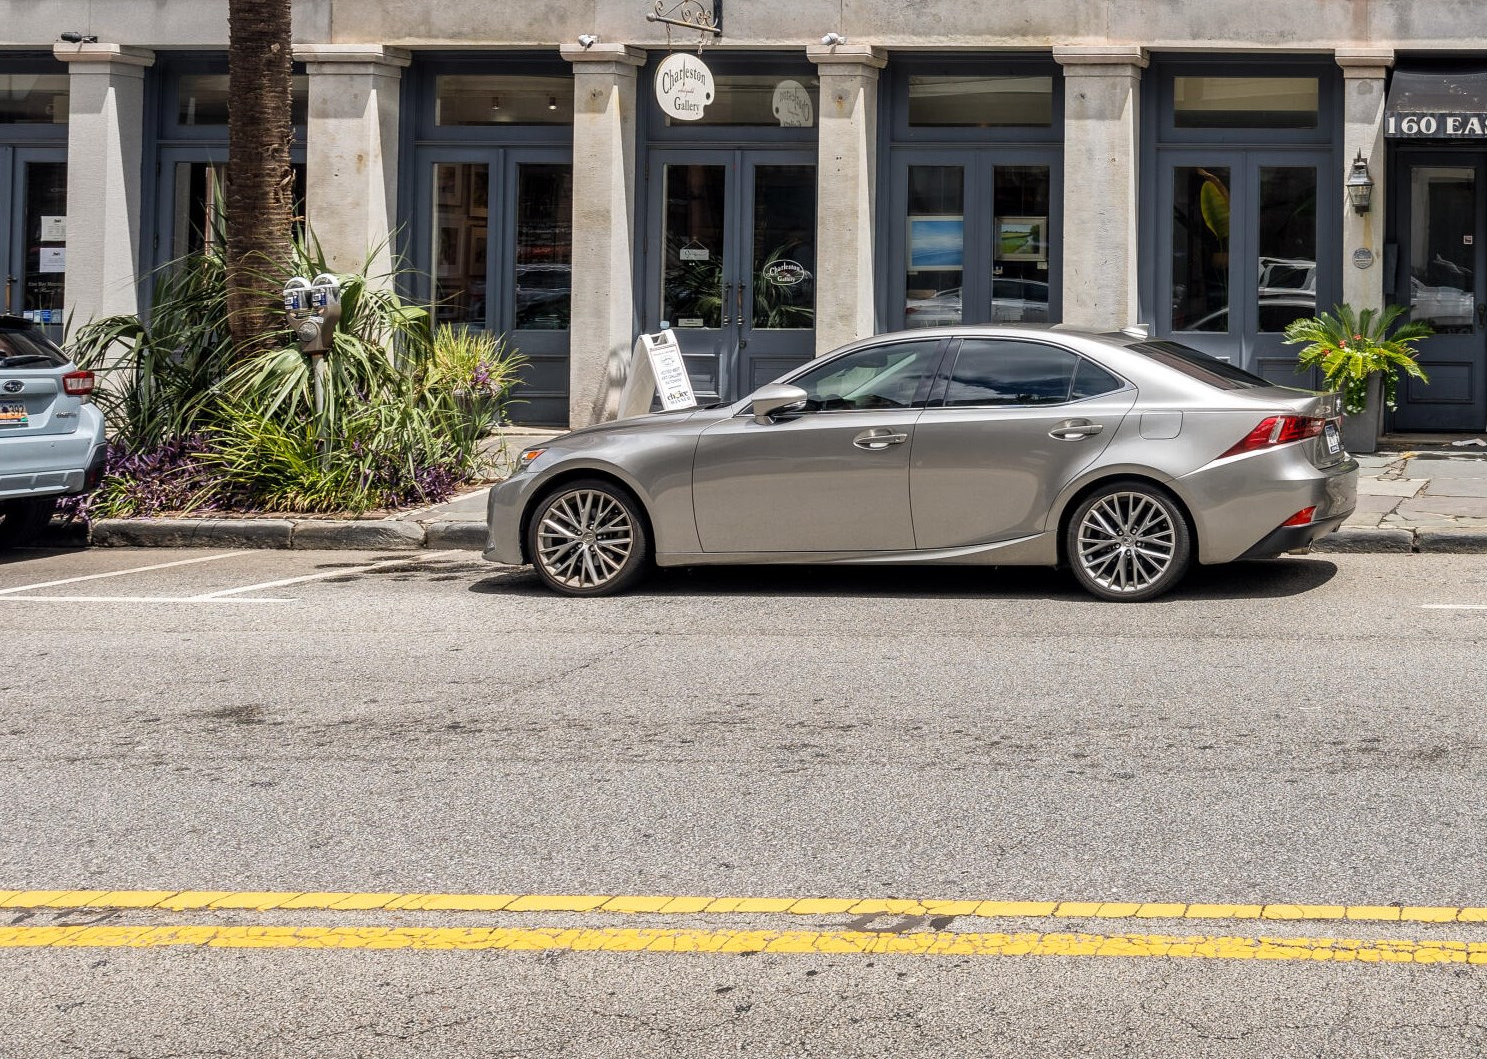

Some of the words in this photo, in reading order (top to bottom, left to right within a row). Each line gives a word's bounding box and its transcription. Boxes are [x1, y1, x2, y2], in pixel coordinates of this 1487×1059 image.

[662, 59, 706, 94] Charleston
[674, 96, 700, 115] Gallery
[1387, 116, 1437, 134] 160
[770, 262, 801, 276] Charleston
